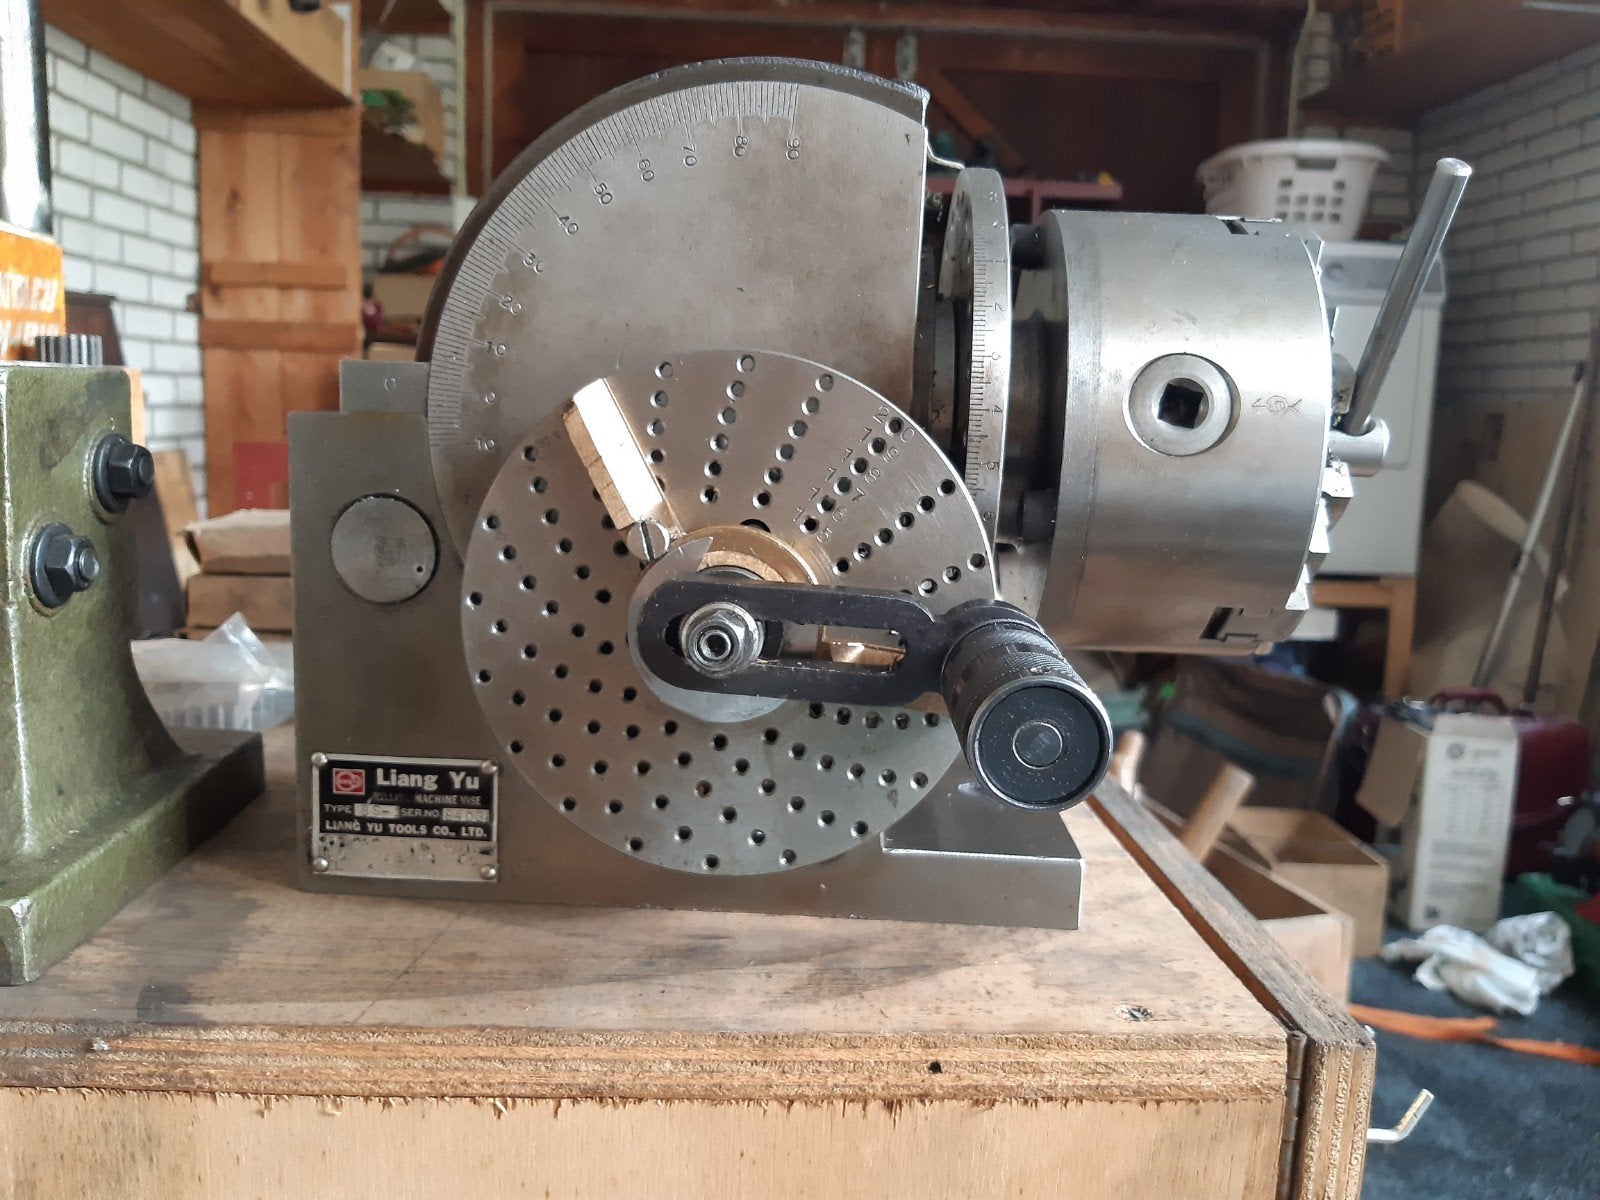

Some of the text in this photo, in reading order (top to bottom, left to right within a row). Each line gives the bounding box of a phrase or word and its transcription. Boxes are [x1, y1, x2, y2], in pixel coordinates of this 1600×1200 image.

[682, 143, 698, 168] 70
[732, 134, 749, 159] 80
[785, 138, 801, 161] 90
[638, 158, 655, 183] 60
[592, 182, 614, 206] 50
[557, 215, 579, 236] 40
[499, 294, 523, 315] 20
[376, 767, 480, 791] Liang Yu
[324, 803, 352, 814] TYPE
[325, 820, 361, 831] LIANG
[367, 823, 383, 833] YU
[389, 825, 427, 835] TOOLS
